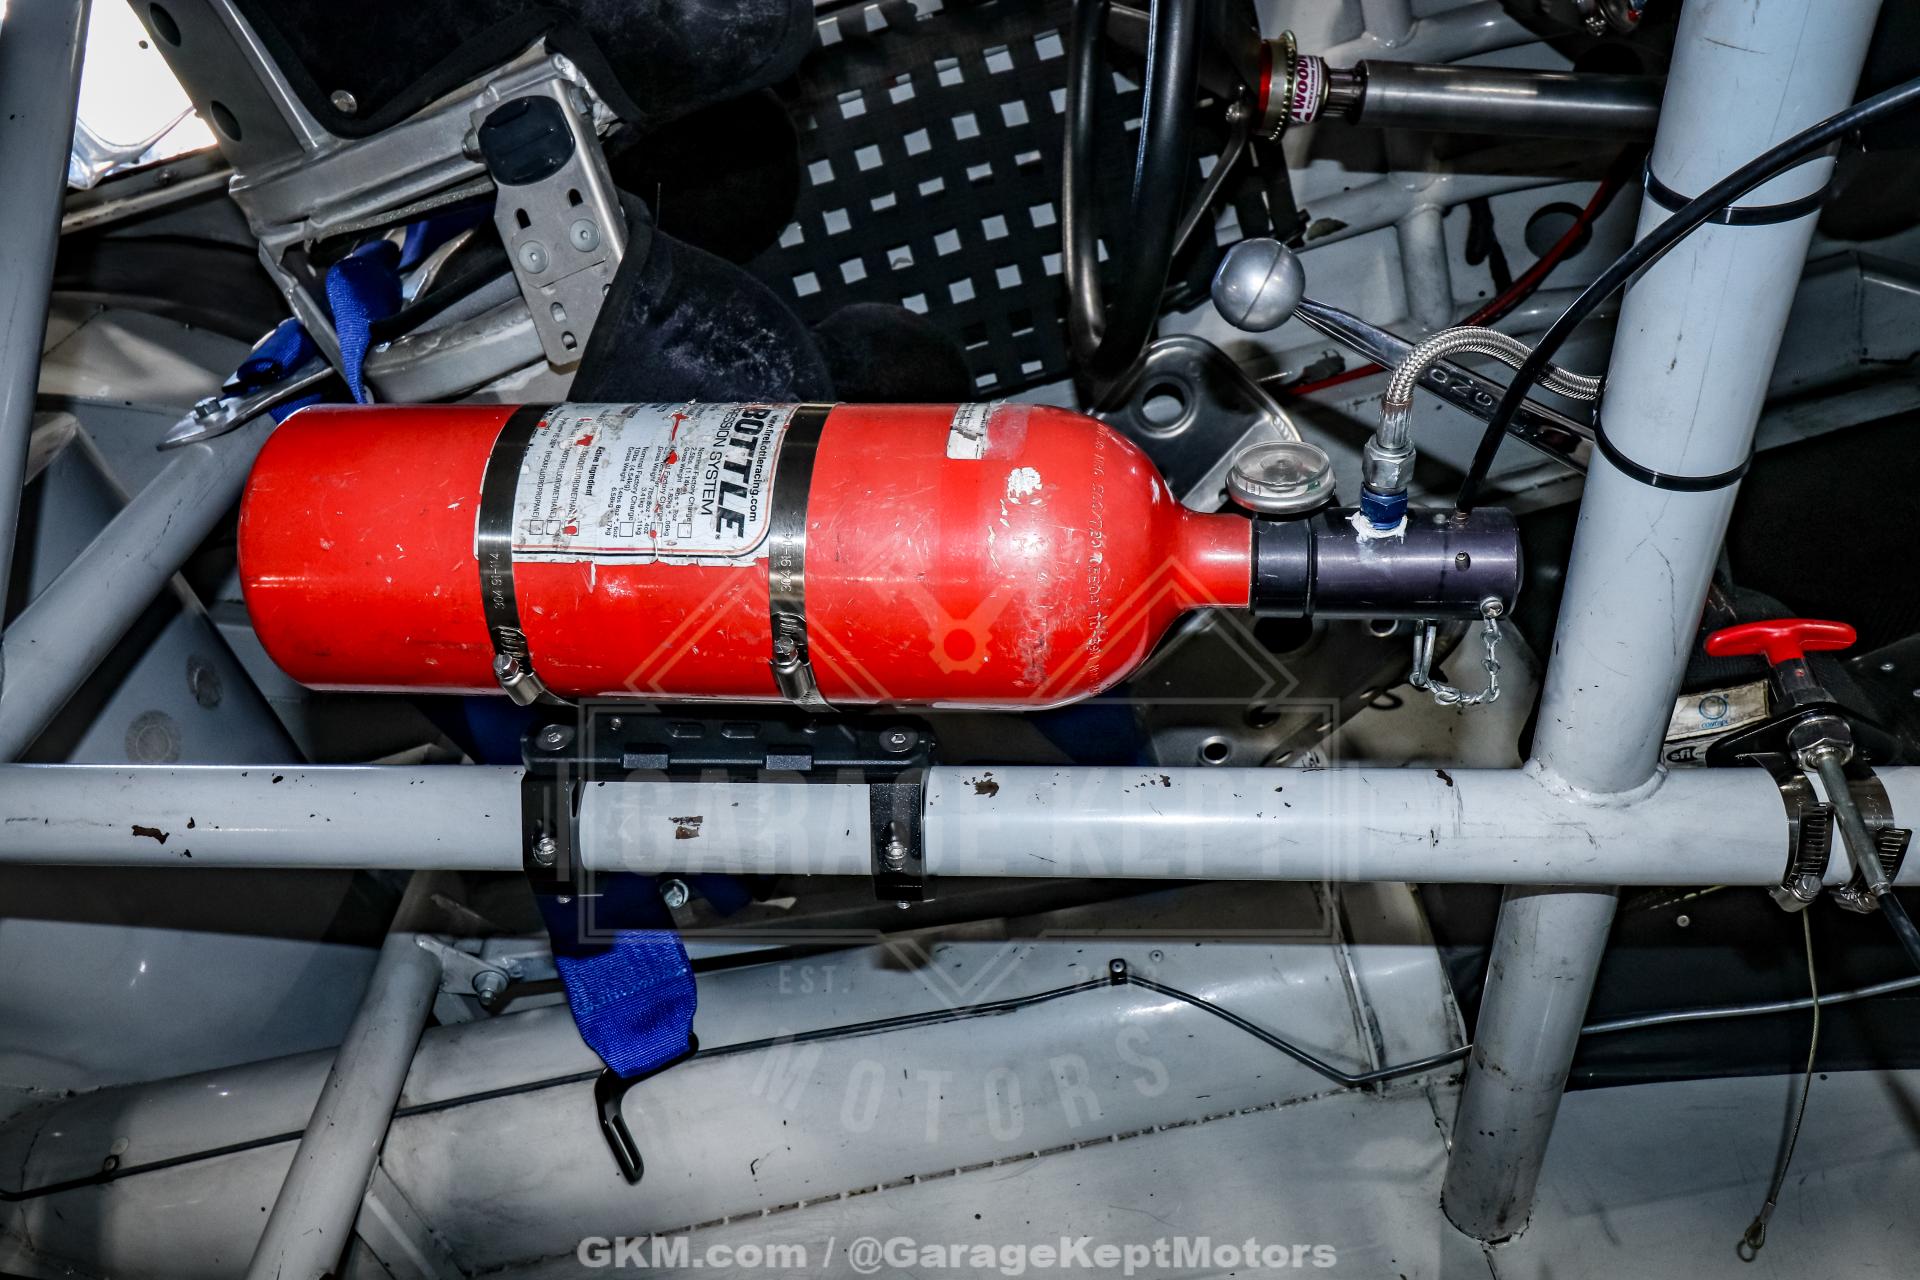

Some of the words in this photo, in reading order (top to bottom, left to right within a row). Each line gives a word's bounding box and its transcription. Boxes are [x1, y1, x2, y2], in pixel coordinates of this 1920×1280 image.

[592, 446, 606, 463] Active
[625, 446, 635, 462] Gross
[638, 446, 650, 470] Nominal
[584, 464, 599, 496] Ingredient
[619, 463, 629, 482] Weight
[630, 470, 643, 495] Factory
[701, 451, 722, 515] SYSTEM
[627, 495, 638, 521] Charge
